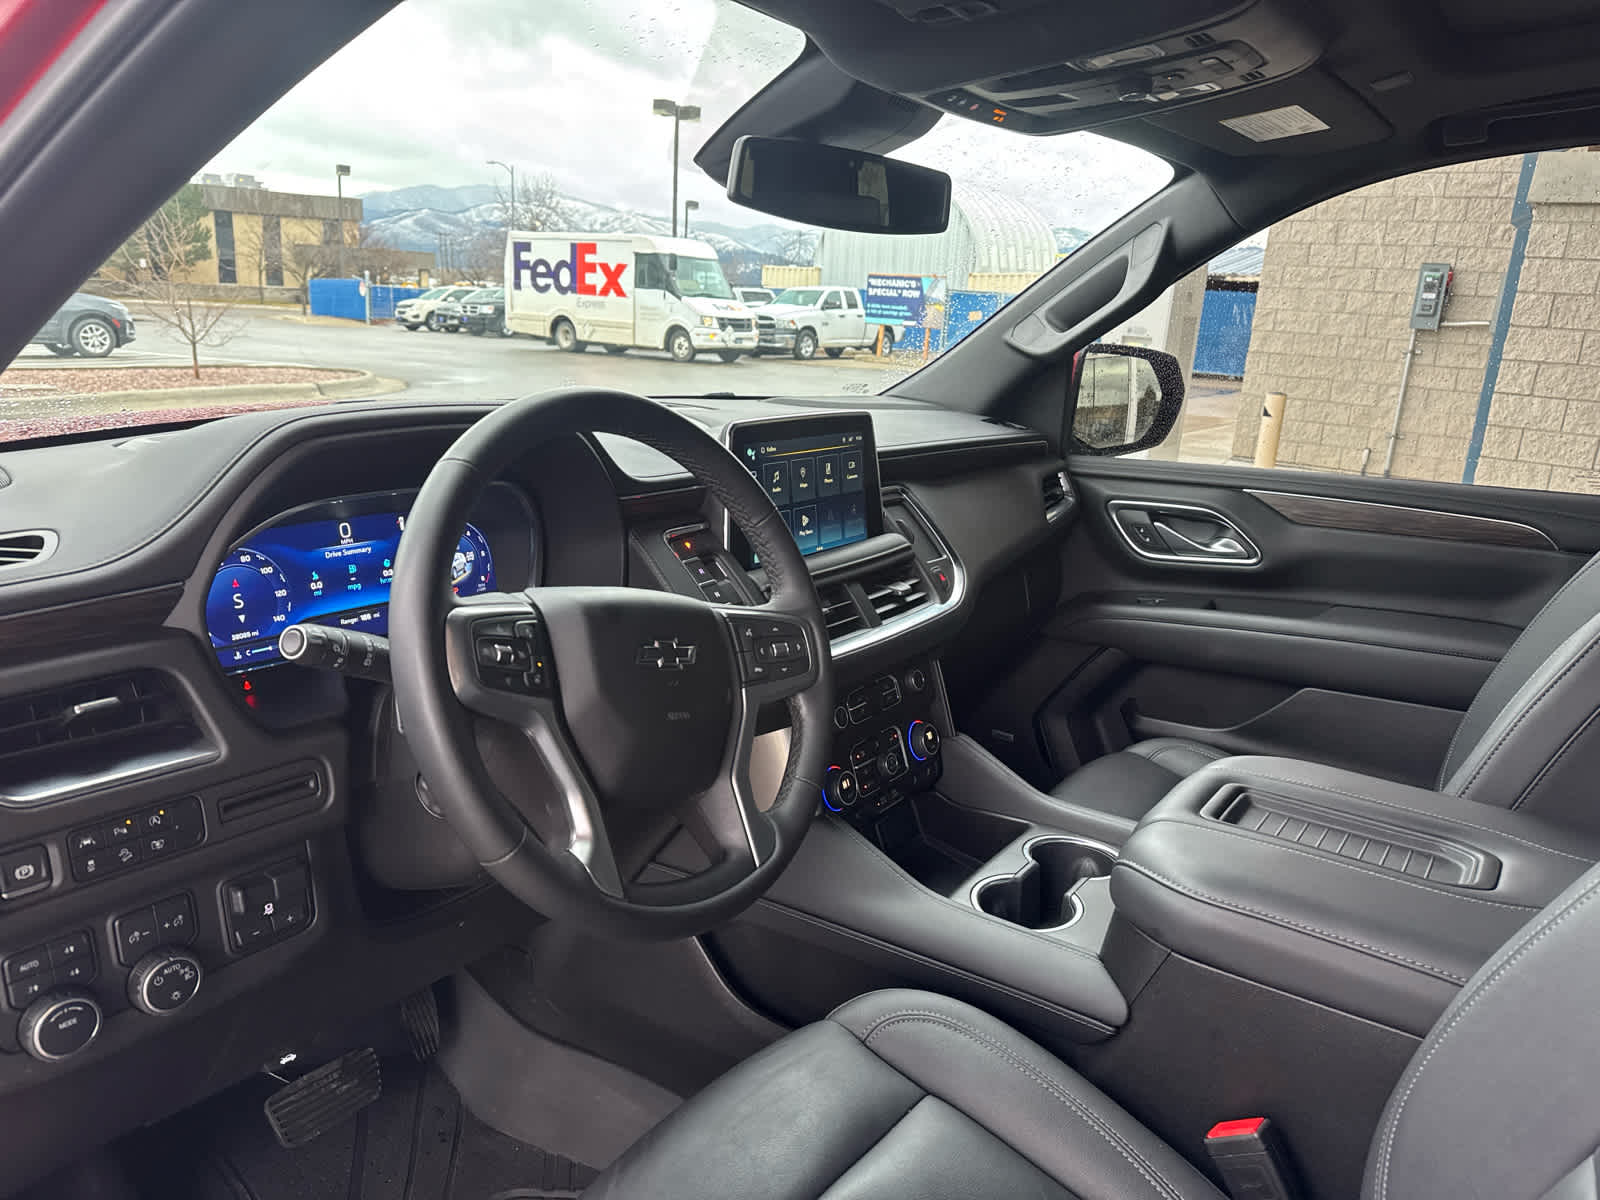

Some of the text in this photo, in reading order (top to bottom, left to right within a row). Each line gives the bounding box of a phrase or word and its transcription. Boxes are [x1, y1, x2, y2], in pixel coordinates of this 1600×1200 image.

[513, 241, 628, 298] FedEx
[339, 522, 351, 538] 0
[325, 546, 372, 559] Drive Summary
[240, 554, 251, 562] 80
[260, 566, 273, 575] 100
[310, 581, 323, 590] 0.0
[347, 583, 362, 591] mpg
[274, 589, 287, 597] 120
[233, 593, 245, 609] S
[272, 614, 286, 622] 140
[20, 960, 39, 972] AUTO
[163, 963, 181, 975] AUTO
